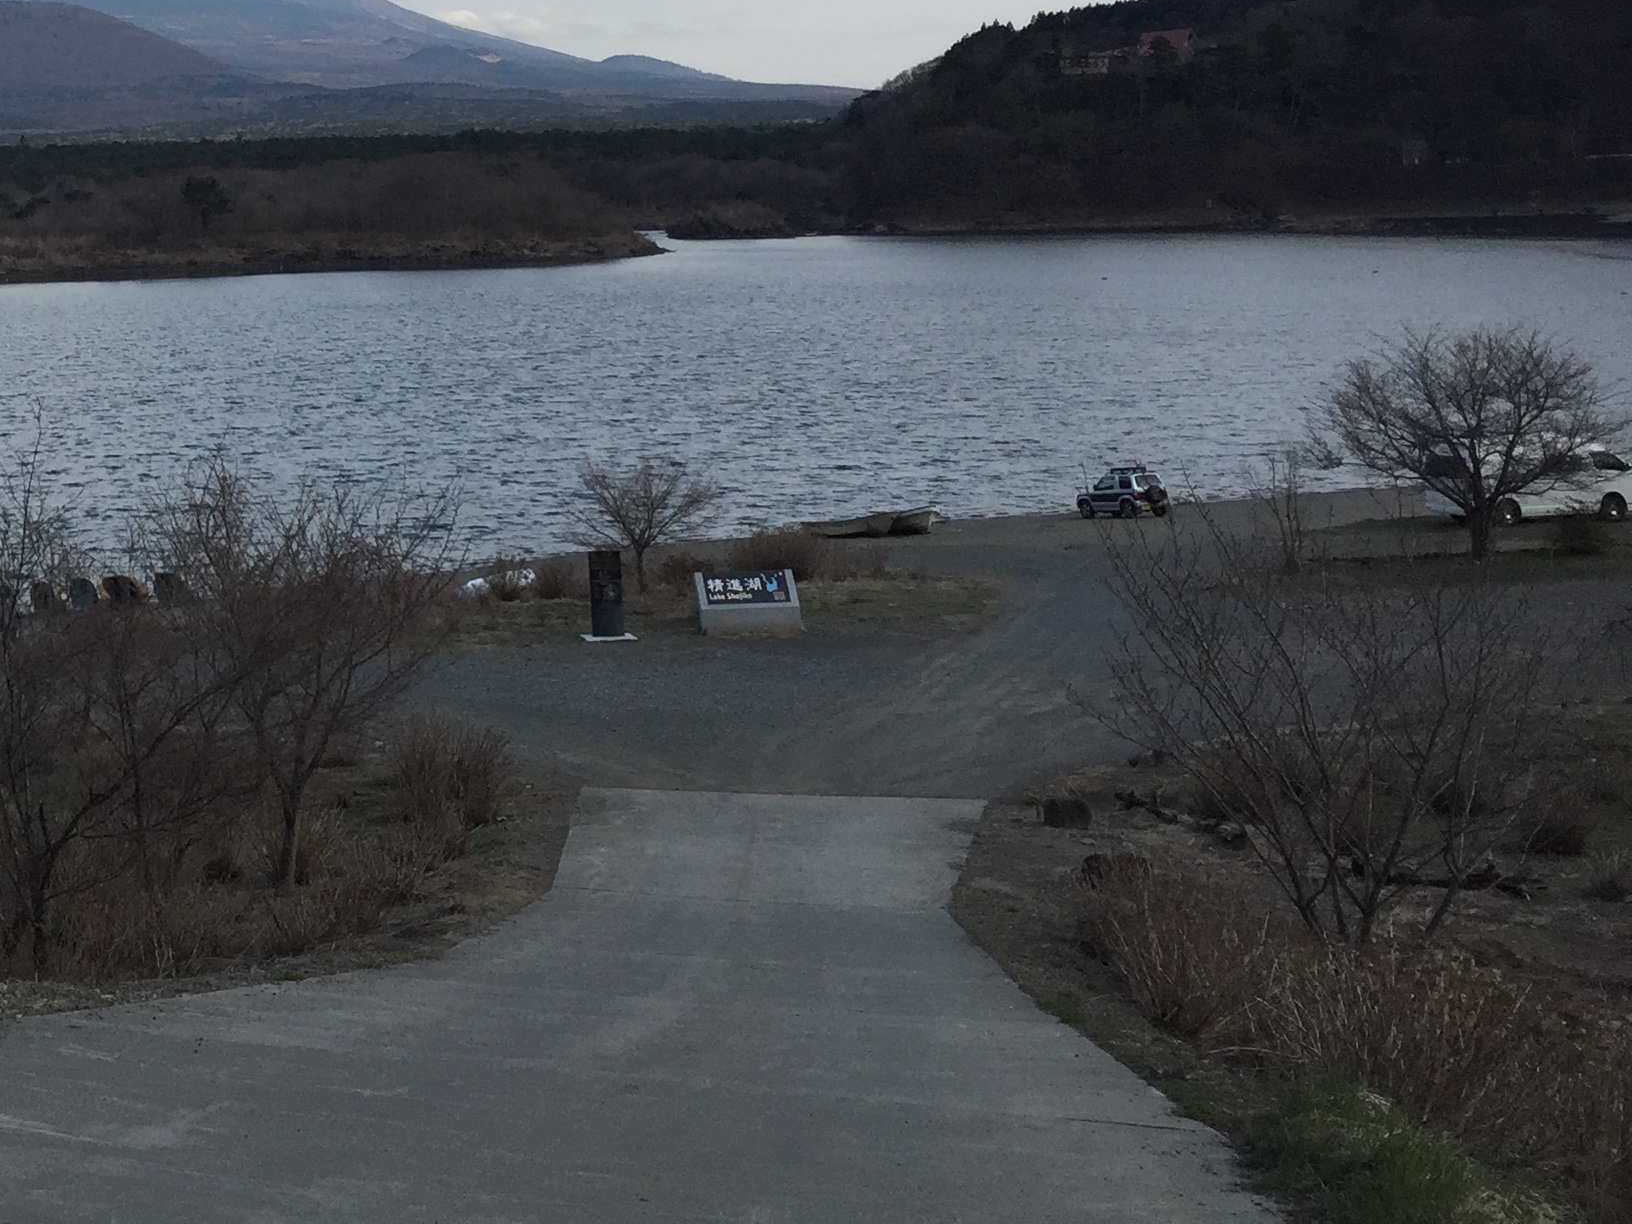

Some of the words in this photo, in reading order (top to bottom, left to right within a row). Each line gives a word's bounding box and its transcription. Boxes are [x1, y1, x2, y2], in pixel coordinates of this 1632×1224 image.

[707, 578, 762, 592] 精進湖
[709, 592, 725, 600] Lake
